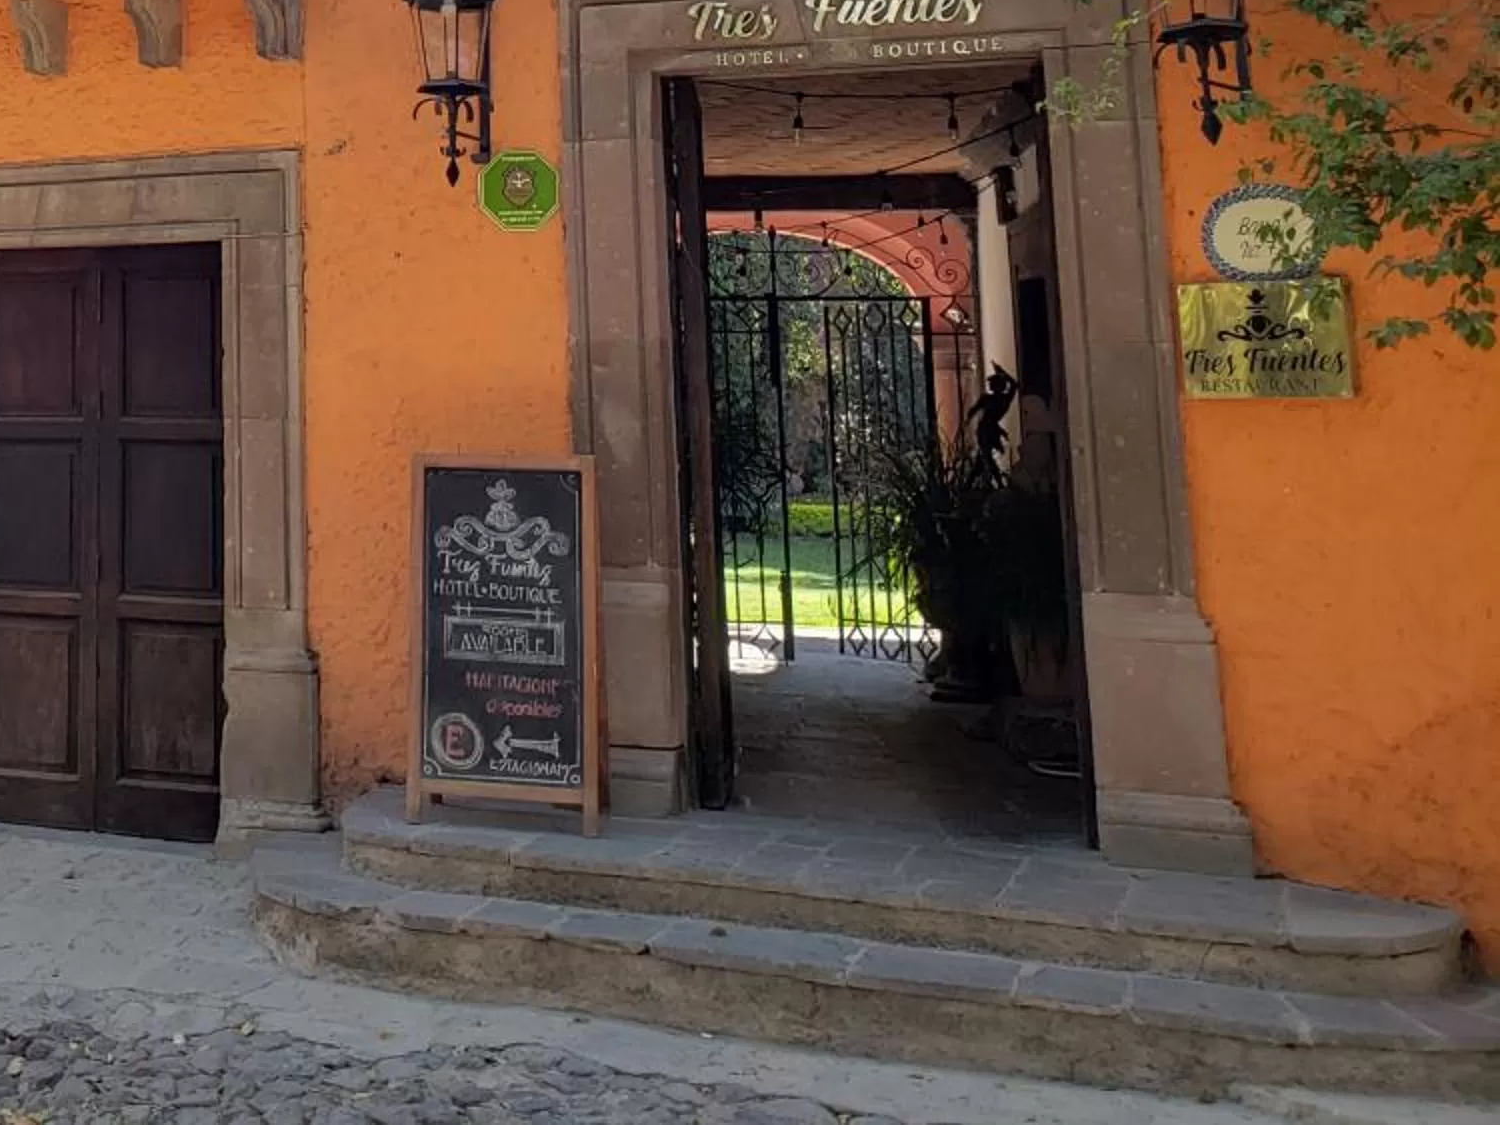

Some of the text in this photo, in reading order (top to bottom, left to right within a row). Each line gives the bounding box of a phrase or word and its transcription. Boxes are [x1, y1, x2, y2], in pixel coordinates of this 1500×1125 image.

[687, 0, 779, 42] Tres
[715, 37, 1004, 68] HOTEL BOUTIQUE
[1184, 347, 1347, 376] Tres Fuentes
